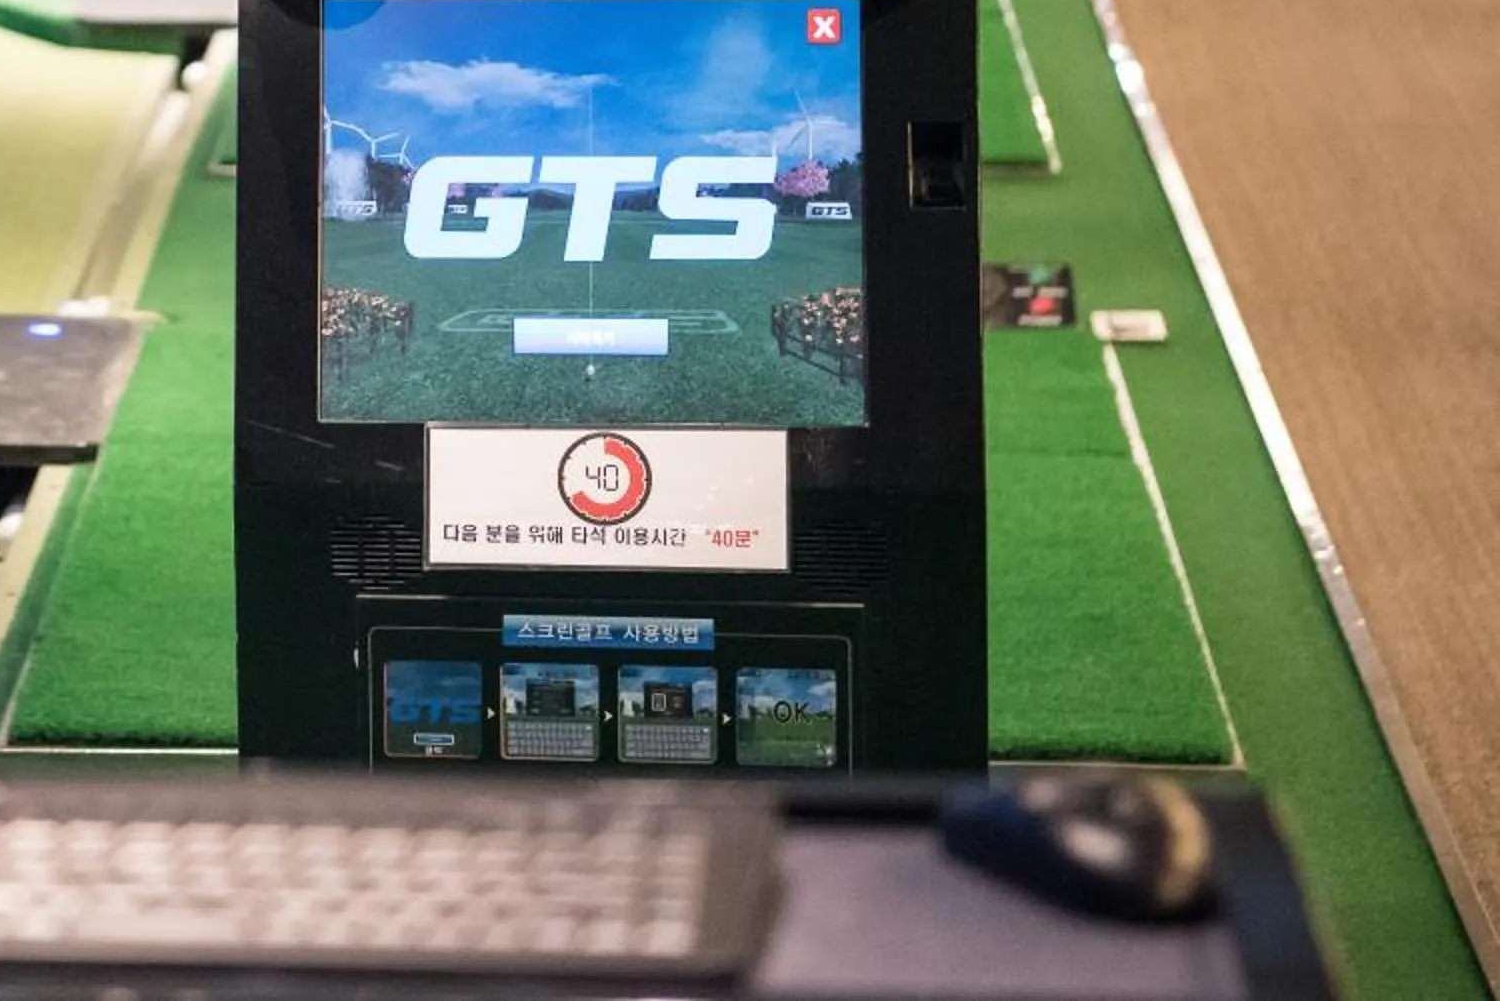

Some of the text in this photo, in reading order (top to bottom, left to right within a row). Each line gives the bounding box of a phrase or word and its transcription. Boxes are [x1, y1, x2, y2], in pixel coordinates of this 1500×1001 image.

[404, 156, 778, 262] GTS
[810, 206, 849, 216] GTS
[585, 464, 619, 492] 40
[443, 524, 478, 543] 다음
[486, 524, 520, 544] 분을
[528, 525, 563, 545] 위해
[571, 525, 607, 545] 타석
[614, 528, 686, 548] 이용시간
[517, 621, 699, 644] 스크린골프 사용방법
[774, 700, 810, 724] OK
